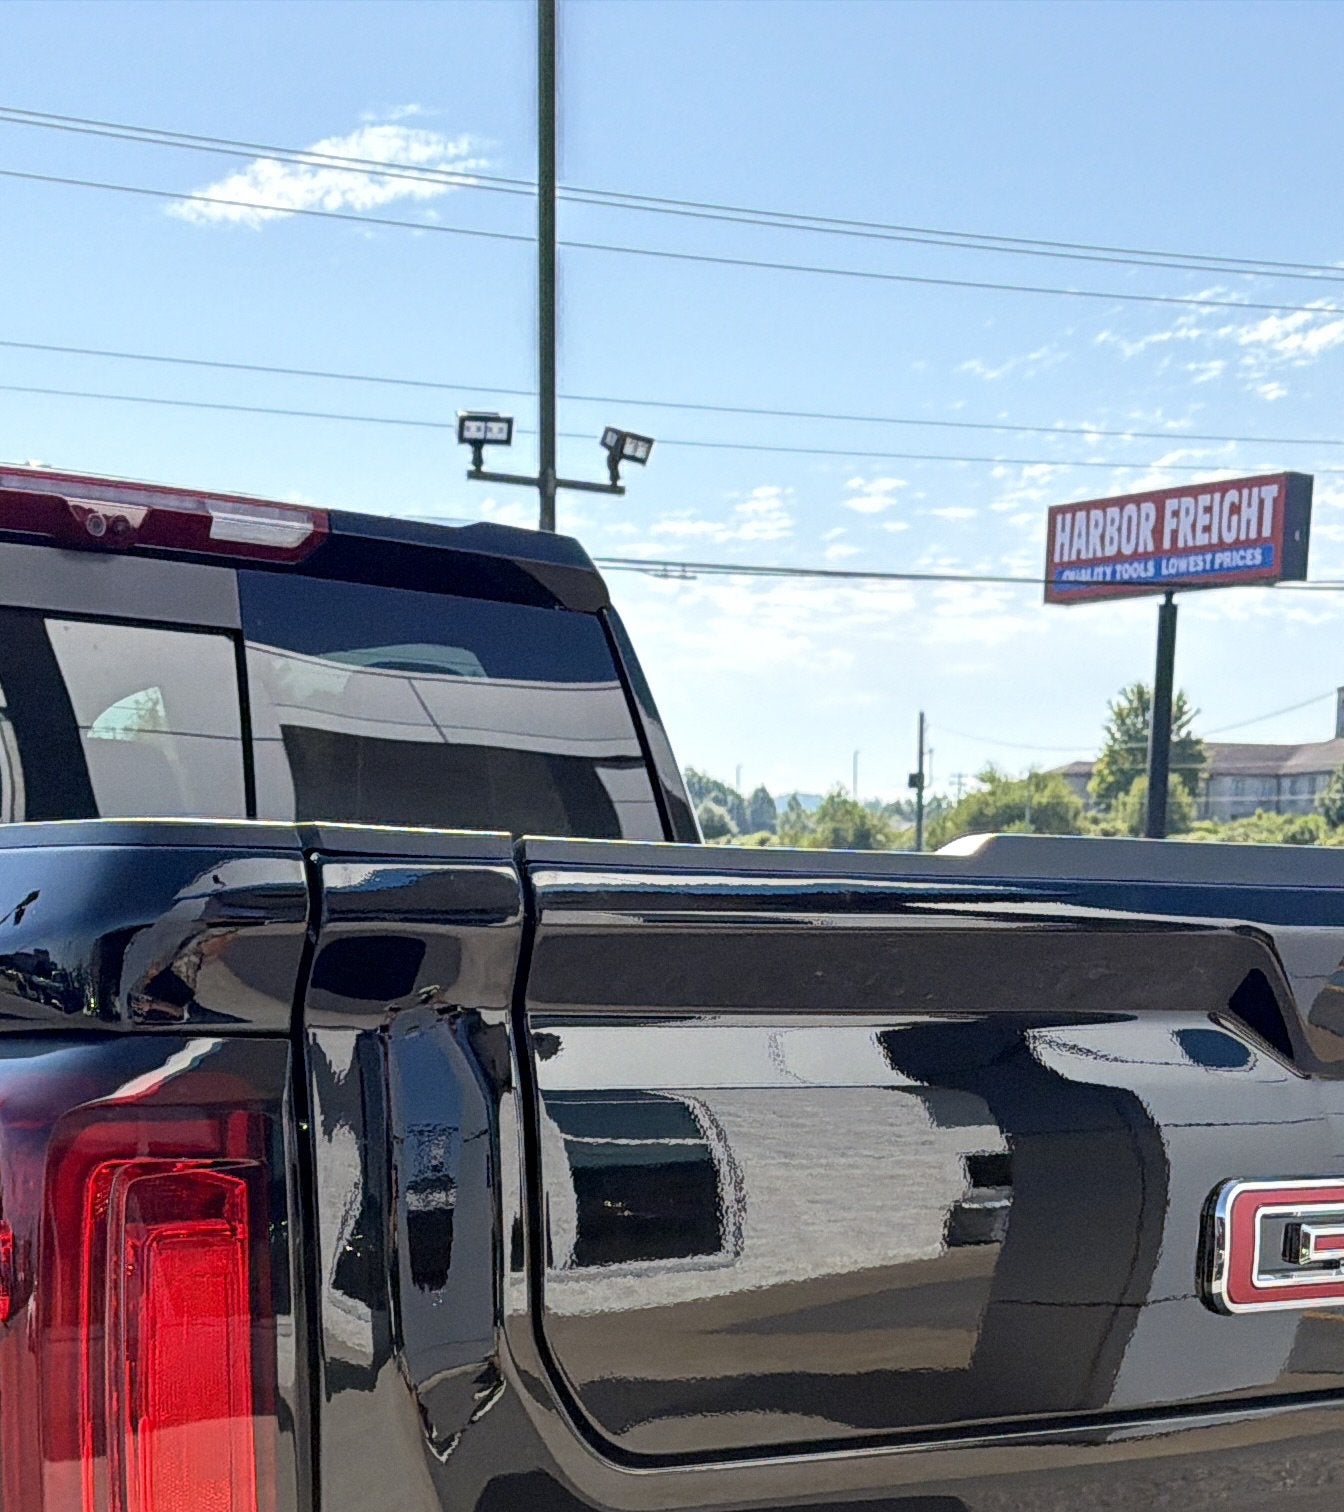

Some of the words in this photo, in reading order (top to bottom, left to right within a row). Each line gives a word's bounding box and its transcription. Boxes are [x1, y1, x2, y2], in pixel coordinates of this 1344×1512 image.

[1054, 502, 1156, 563] HARBOR
[1163, 484, 1279, 550] FREIGHT
[1114, 560, 1155, 580] TOOLS
[1161, 552, 1212, 576] LOWEST
[1213, 547, 1262, 570] PRICES
